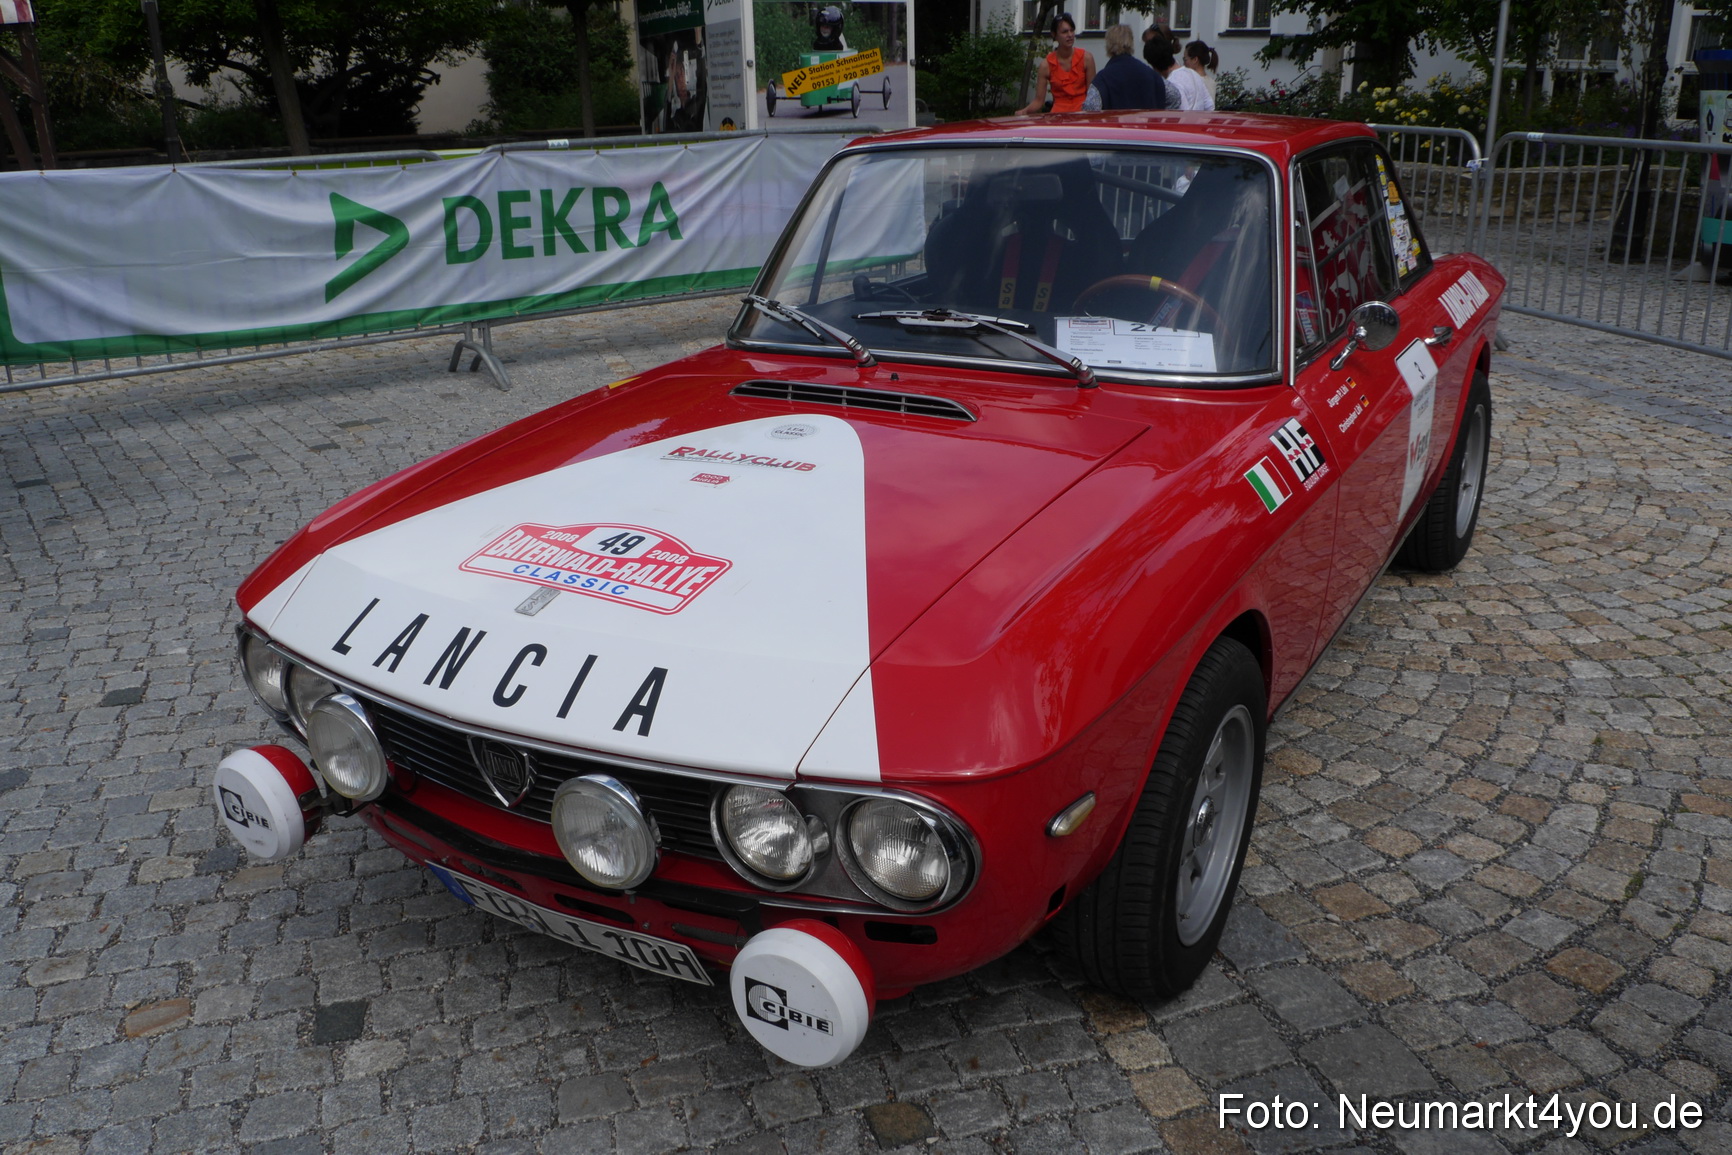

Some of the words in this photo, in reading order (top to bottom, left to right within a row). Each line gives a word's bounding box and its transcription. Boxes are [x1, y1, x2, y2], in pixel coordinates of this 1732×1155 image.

[808, 63, 834, 75] Station
[836, 51, 878, 67] Schnaittach
[788, 71, 807, 94] NEU
[811, 78, 835, 90] 09153
[843, 71, 858, 81] 920
[860, 68, 870, 77] 38
[871, 65, 881, 73] 29
[442, 181, 684, 265] DEKRA
[668, 446, 817, 473] RALLYCLUB
[1269, 417, 1321, 482] HF
[541, 530, 580, 543] 2008
[596, 532, 647, 556] 49
[484, 528, 720, 597] BAYERWALD-RALLYE
[649, 549, 690, 565] 2008
[512, 564, 630, 596] CLASSIC
[330, 597, 669, 738] LANCIA
